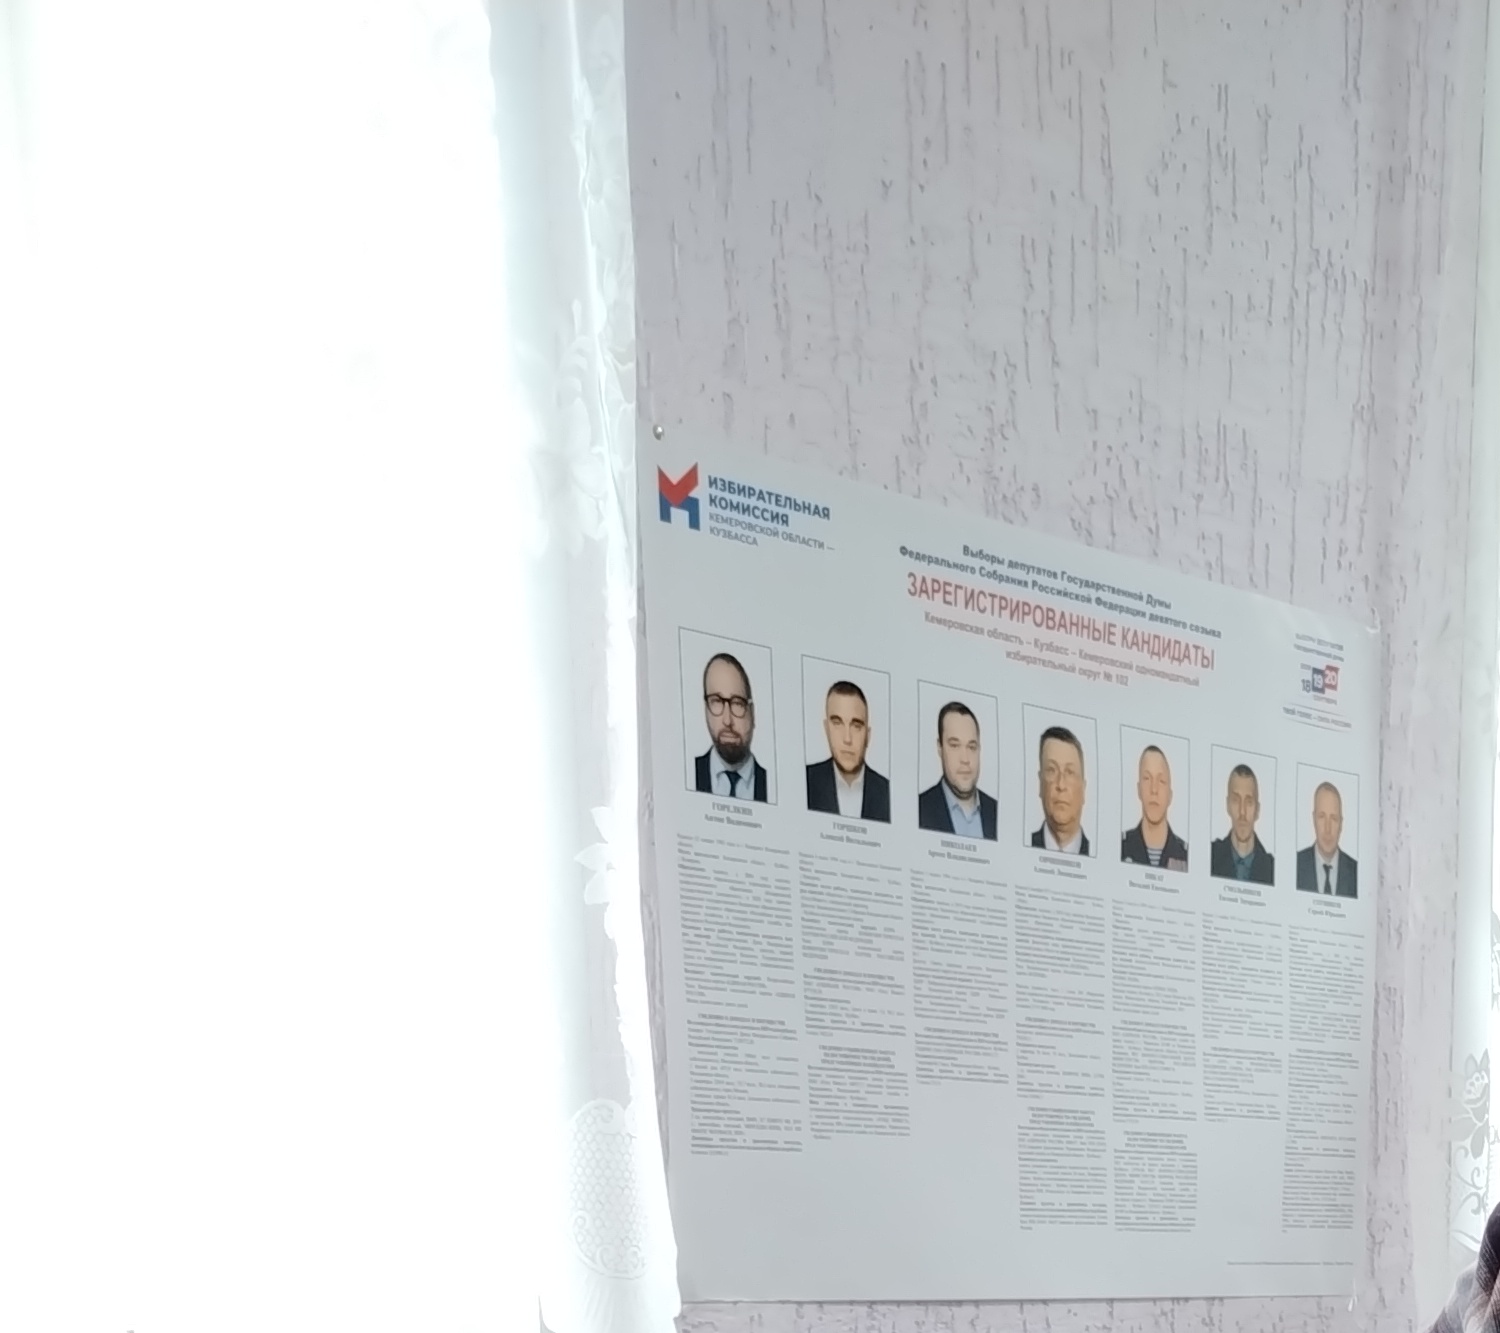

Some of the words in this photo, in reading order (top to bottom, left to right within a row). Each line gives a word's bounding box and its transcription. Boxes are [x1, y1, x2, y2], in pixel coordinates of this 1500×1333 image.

[708, 475, 831, 521] ИЗБИРАТЕЛЬНАЯ
[708, 494, 789, 527] КОМИССИЯ
[709, 512, 779, 538] КЕМЕРОВСКОЙ
[781, 533, 825, 551] ОБЛАСТИ
[709, 525, 758, 546] КУЗБАССА
[900, 545, 976, 575] Федерального
[979, 566, 1029, 588] Собрания
[1032, 579, 1092, 604] Российской
[1095, 596, 1146, 618] Федерации
[1148, 612, 1187, 630] девятого
[1189, 623, 1221, 639] созыва
[962, 545, 1005, 566] Выборы
[1007, 559, 1058, 580] депутатов
[1061, 571, 1144, 602] Государственной
[1146, 593, 1171, 609] Думы
[907, 572, 1117, 646] ЗАРЕГИСТРИРОВАННЫЕ
[1121, 625, 1214, 670] КАНДИДАТЫ
[925, 611, 984, 636] Кемеровская
[987, 628, 1024, 646] область
[1324, 669, 1336, 686] 20
